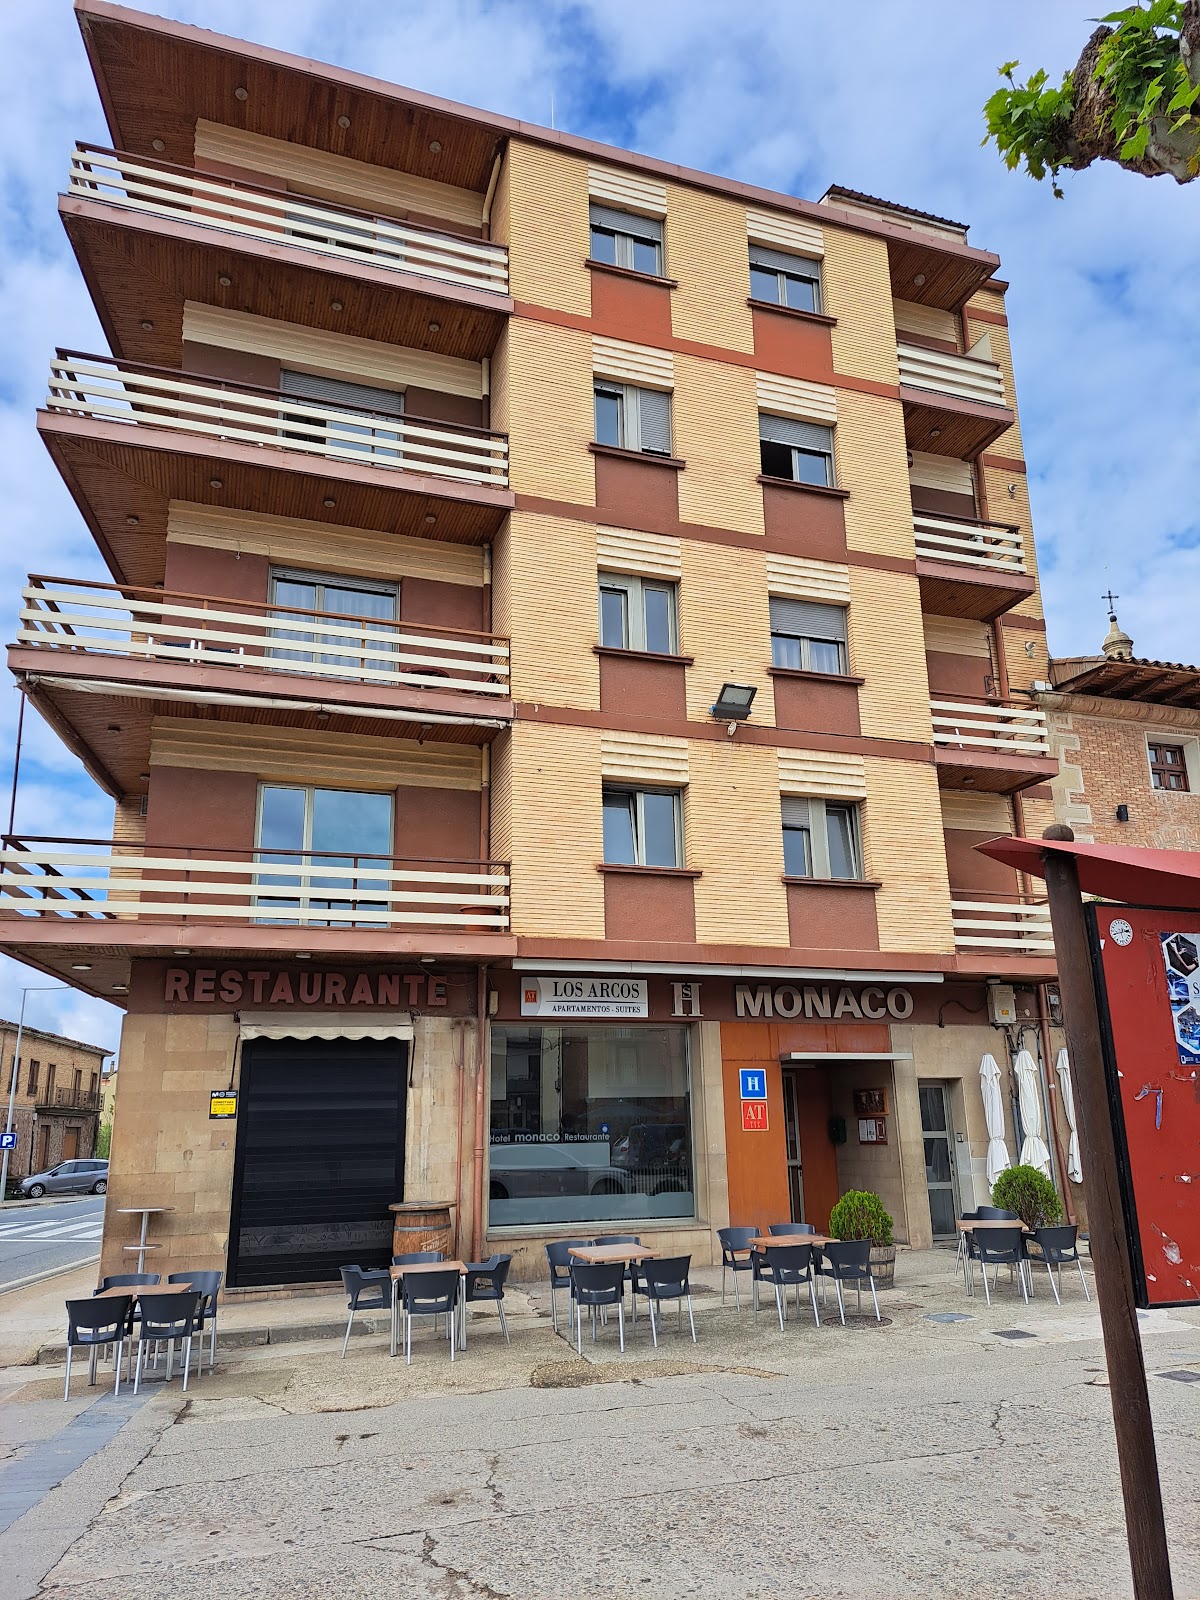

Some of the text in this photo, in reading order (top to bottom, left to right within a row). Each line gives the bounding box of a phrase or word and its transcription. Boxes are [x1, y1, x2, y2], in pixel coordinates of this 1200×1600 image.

[164, 968, 448, 1006] RESTAURANTE
[552, 981, 640, 999] LOS ARCOS
[552, 1005, 610, 1013] APARTAMENTOS
[615, 1006, 641, 1014] SUITES
[735, 984, 914, 1019] MONACO
[745, 1104, 765, 1120] AT
[2, 1135, 13, 1147] P
[490, 1132, 610, 1143] Hotel monaco Restaurante
